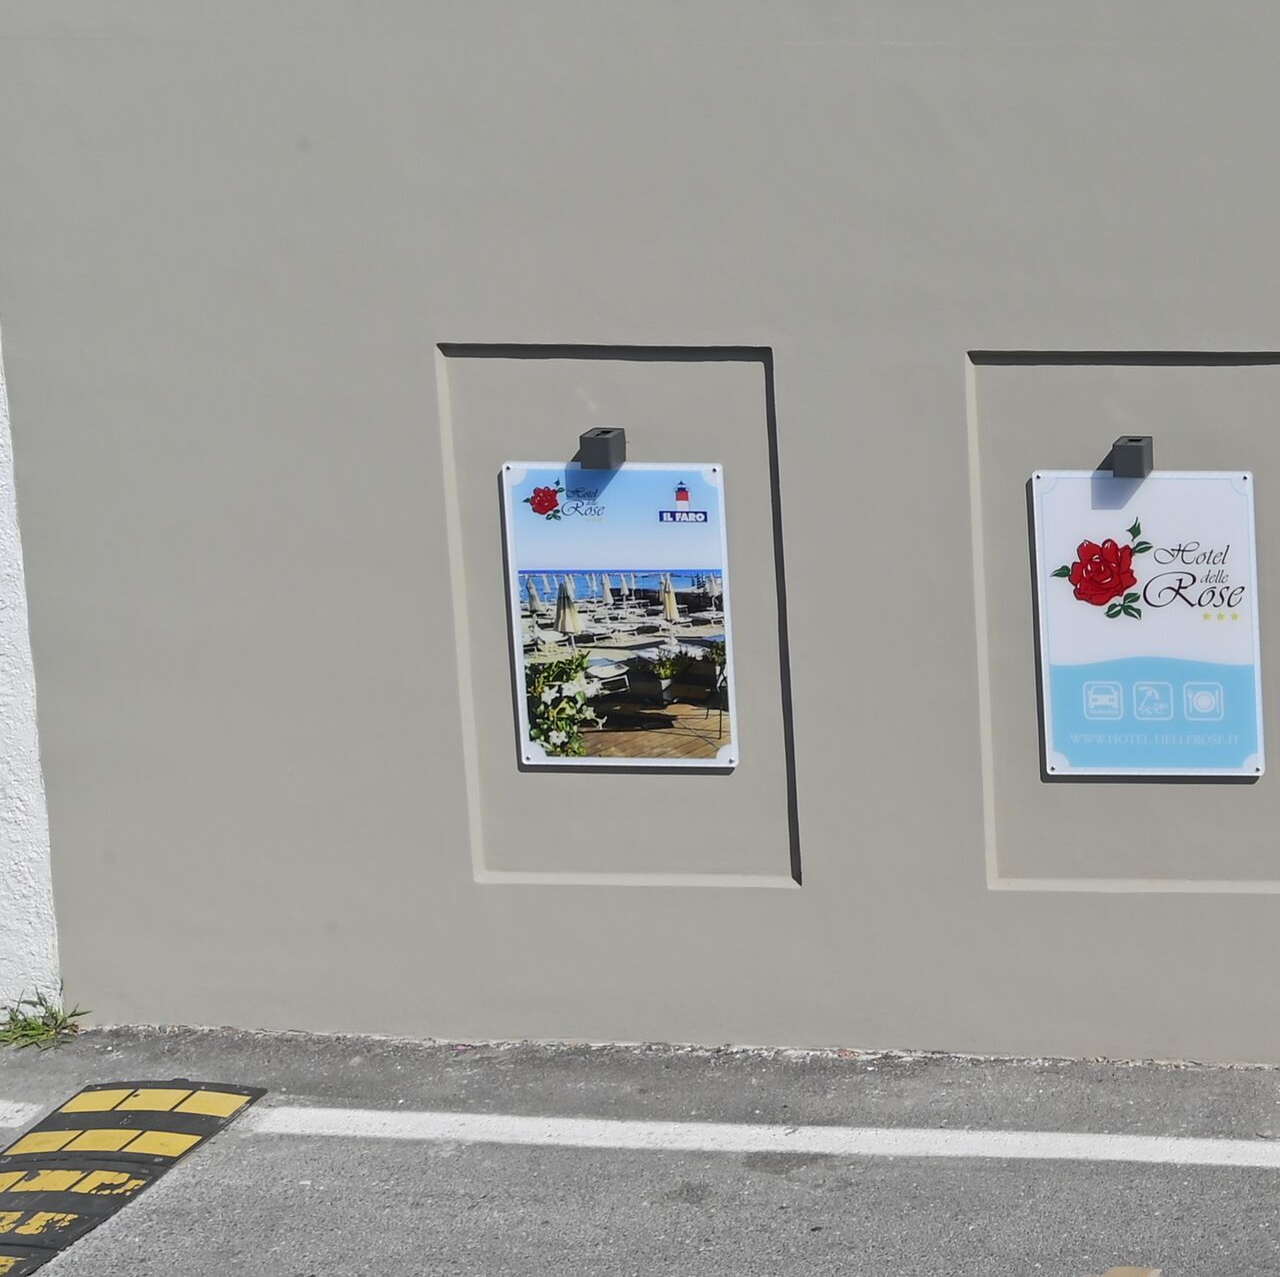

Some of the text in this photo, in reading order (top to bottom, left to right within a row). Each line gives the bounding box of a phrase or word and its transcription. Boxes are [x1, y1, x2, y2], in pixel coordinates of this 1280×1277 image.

[561, 500, 605, 516] Rose
[663, 512, 705, 522] IL FARO
[1153, 541, 1230, 565] Hotel
[1200, 569, 1229, 583] delle
[1143, 571, 1245, 608] Rose
